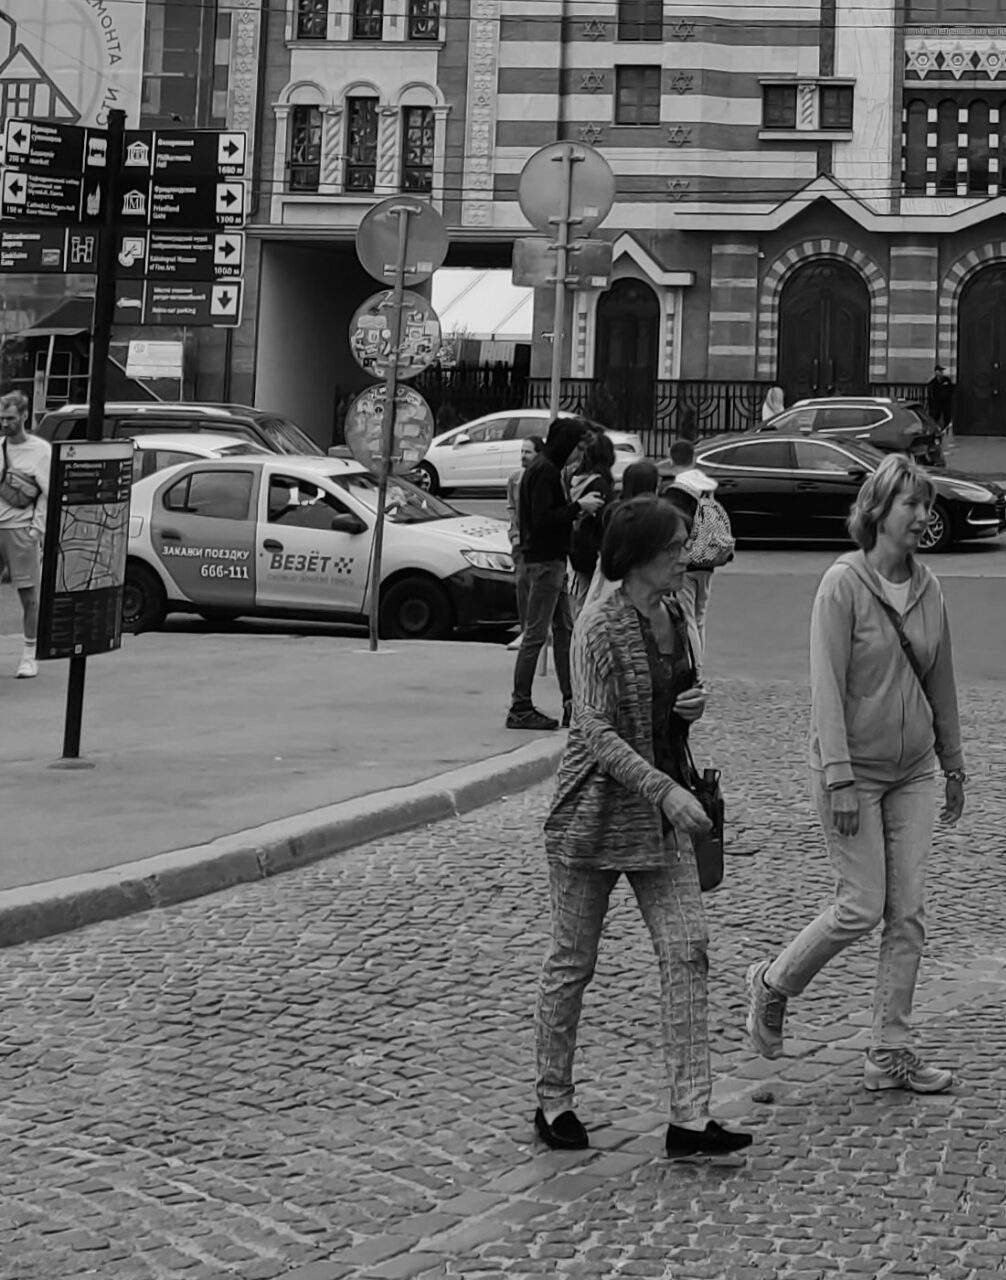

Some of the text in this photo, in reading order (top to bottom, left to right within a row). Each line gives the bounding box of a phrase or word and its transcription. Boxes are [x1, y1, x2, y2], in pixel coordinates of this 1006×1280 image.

[161, 545, 250, 560] ЗАКАЖИ ПОЕЗДКУ
[269, 550, 331, 573] ВЕЗЁТ
[201, 565, 250, 579] 666-111
